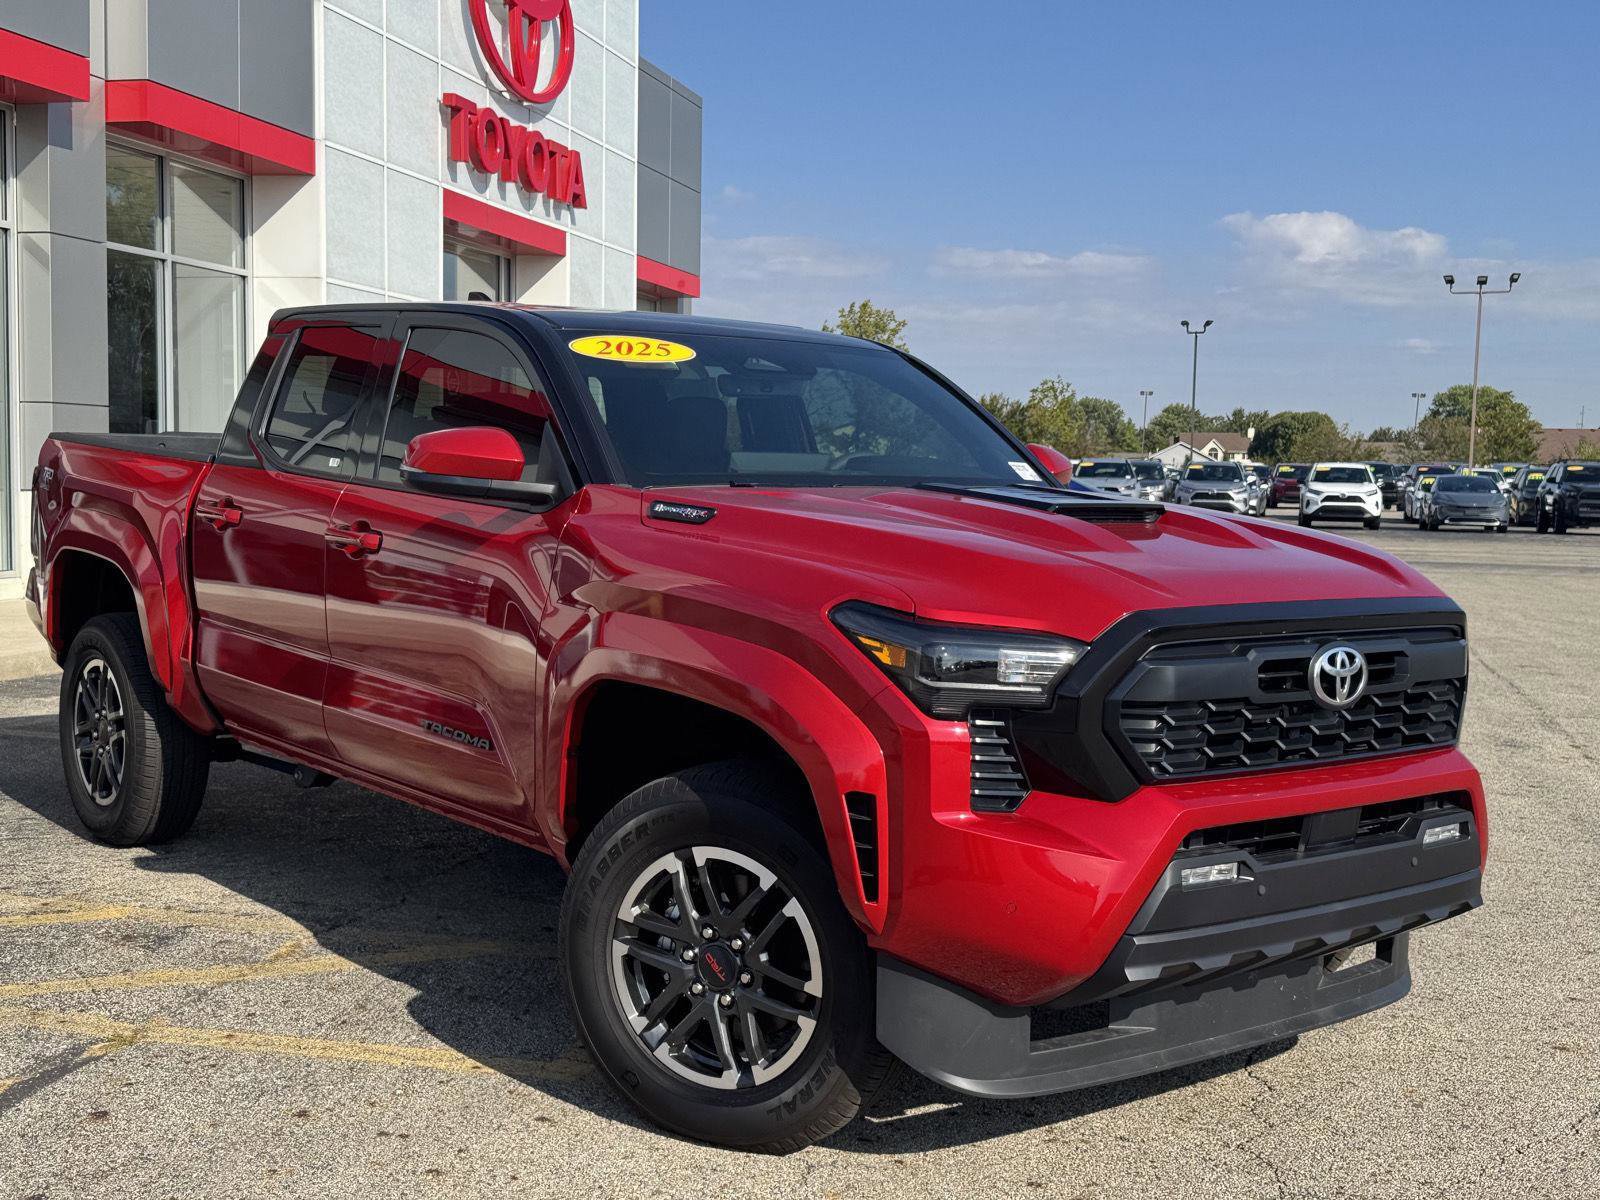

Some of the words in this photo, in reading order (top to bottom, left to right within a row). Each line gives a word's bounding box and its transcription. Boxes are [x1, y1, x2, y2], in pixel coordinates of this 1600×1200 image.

[442, 93, 587, 209] TOYOTA
[595, 340, 672, 357] 2025
[421, 718, 491, 751] TACOMA
